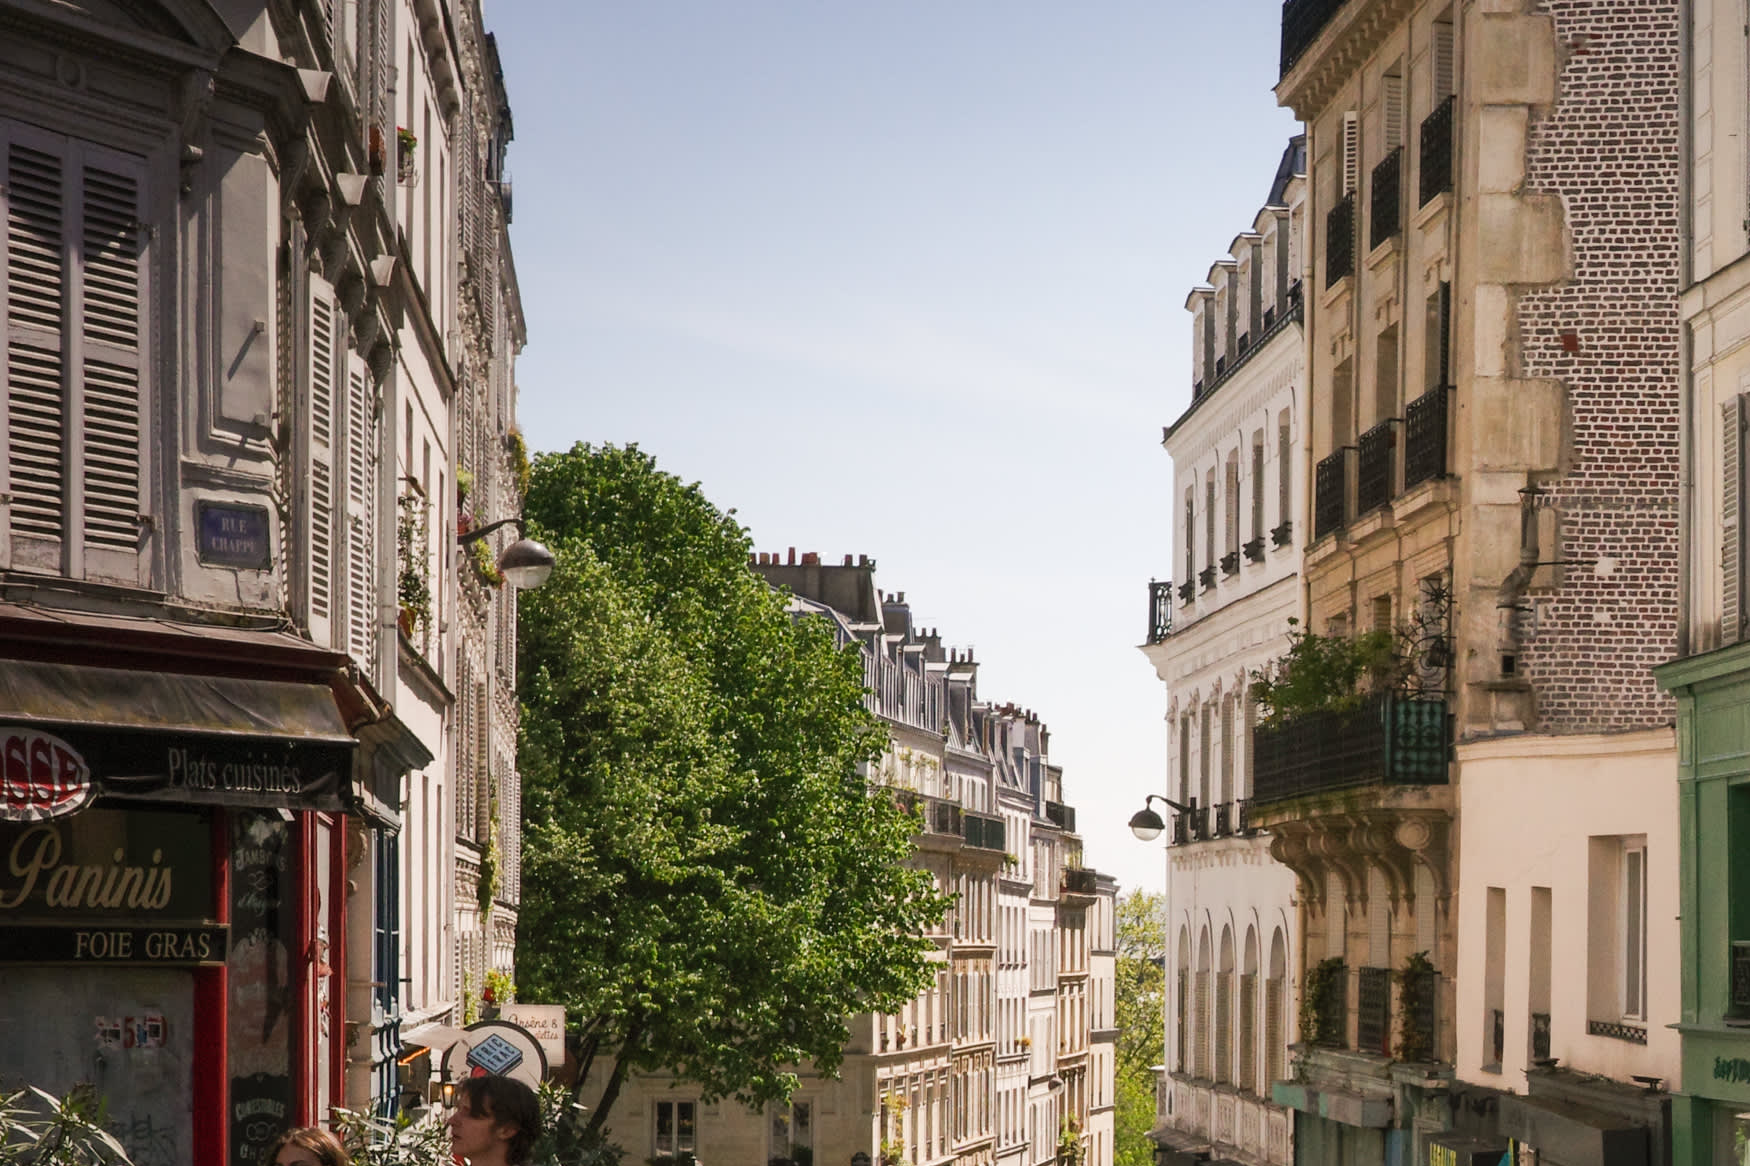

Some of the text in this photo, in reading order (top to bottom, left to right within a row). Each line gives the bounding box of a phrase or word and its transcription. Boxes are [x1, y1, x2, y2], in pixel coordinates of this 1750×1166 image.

[221, 517, 248, 534] RUE
[168, 746, 301, 794] Plats cuisinés
[0, 824, 172, 910] Paninis
[235, 848, 287, 872] JAMBS
[74, 931, 211, 959] FOIE GRAS
